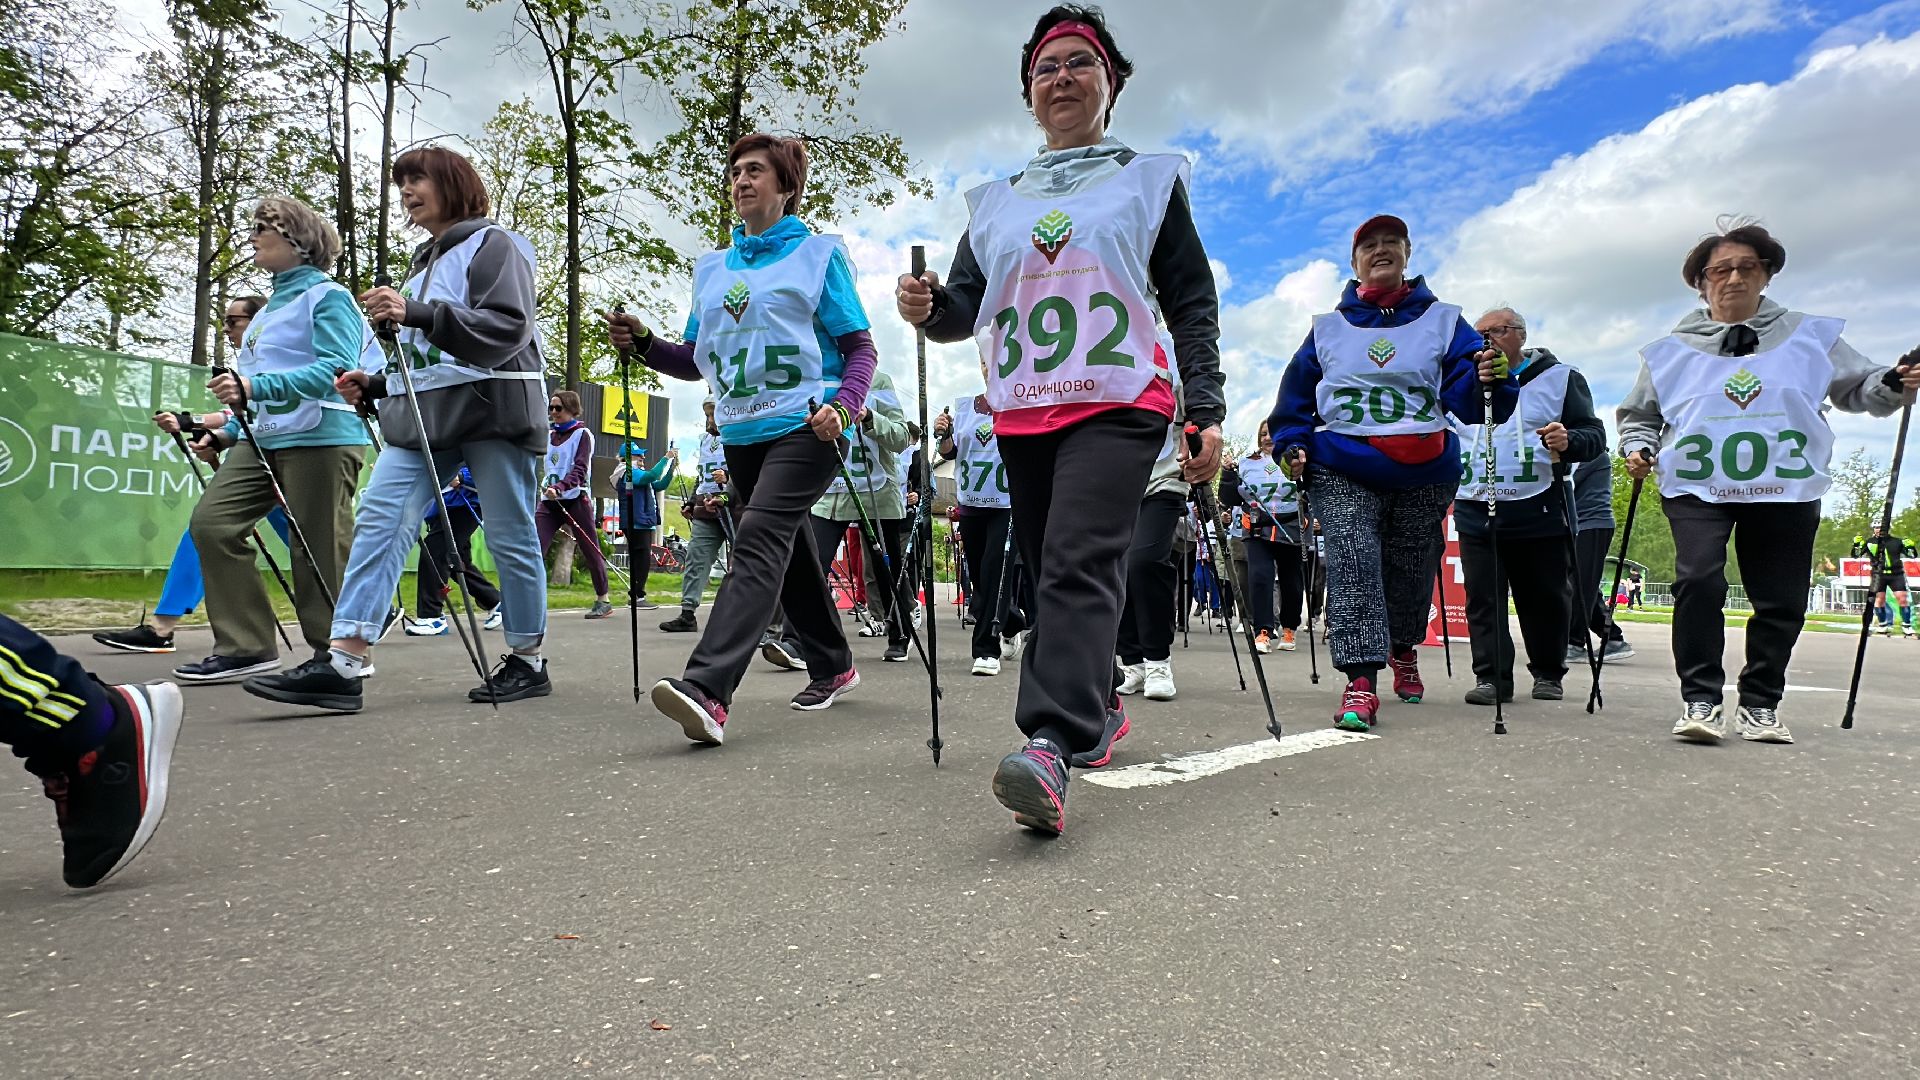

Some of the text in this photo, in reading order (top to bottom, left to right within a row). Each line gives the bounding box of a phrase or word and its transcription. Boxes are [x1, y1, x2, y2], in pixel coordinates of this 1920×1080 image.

[995, 291, 1136, 380] 392
[722, 399, 778, 418] Одинцово
[1014, 379, 1095, 400] Одинцово
[1333, 386, 1437, 425] 302
[51, 424, 208, 465] ПАРК
[1674, 430, 1816, 481] 303
[1709, 485, 1785, 499] Одинцово
